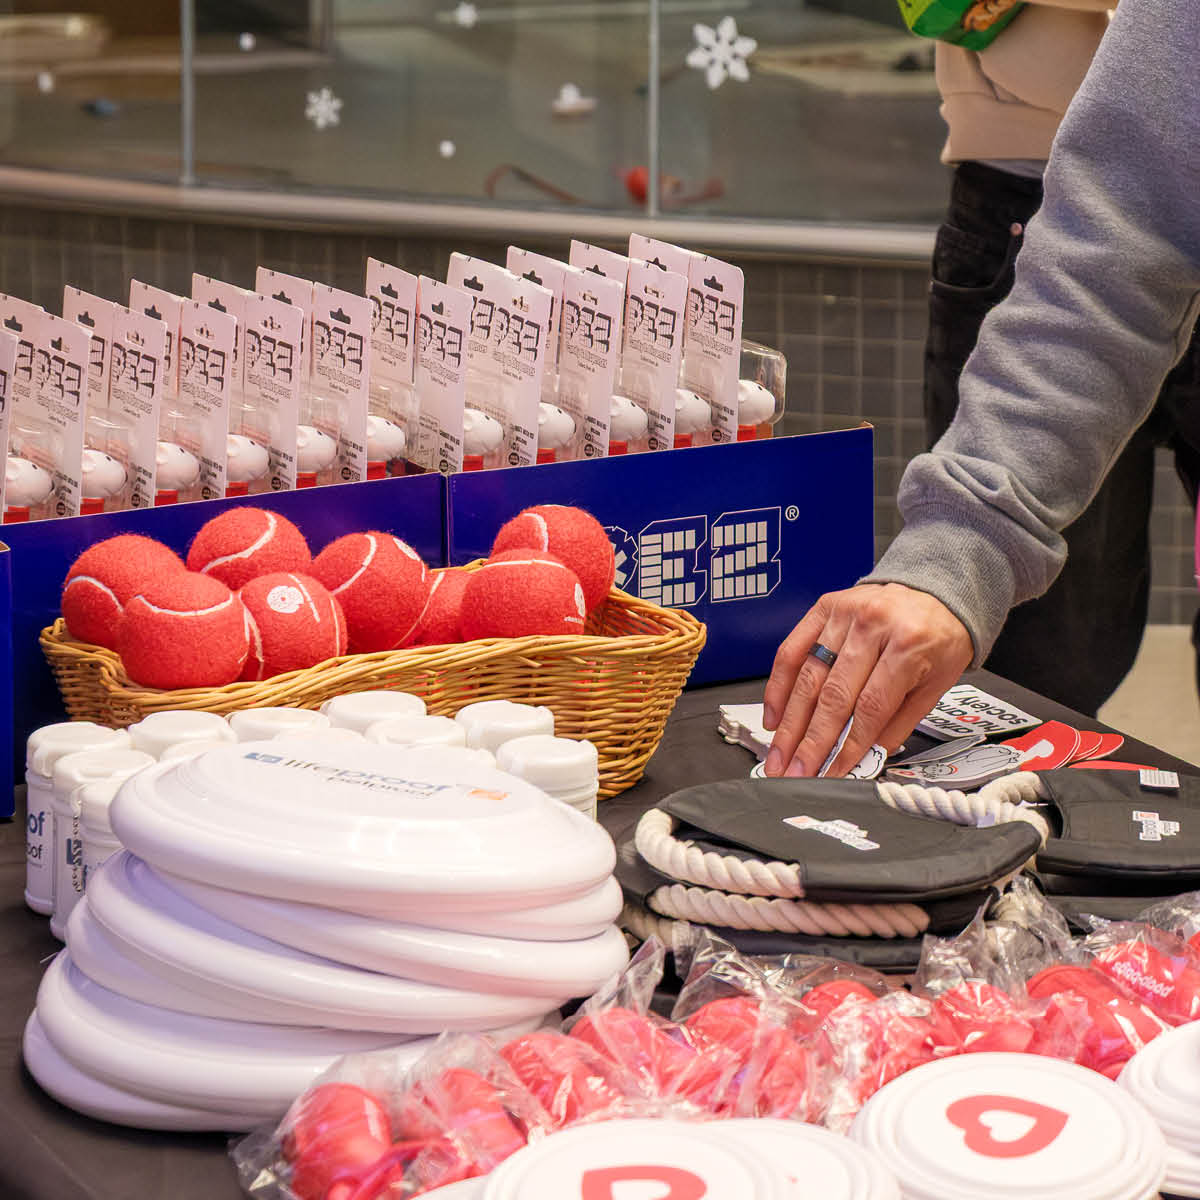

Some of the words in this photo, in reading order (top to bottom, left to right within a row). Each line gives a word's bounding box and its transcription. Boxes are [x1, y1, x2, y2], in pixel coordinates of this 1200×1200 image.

[420, 313, 462, 368] PEZ
[498, 308, 540, 362] PEZ
[566, 299, 611, 353] PEZ
[630, 294, 677, 349] PEZ
[690, 288, 735, 342] PEZ
[247, 328, 293, 383] PEZ
[315, 320, 363, 374] PEZ
[925, 713, 974, 734] atlan
[953, 695, 1028, 725] society
